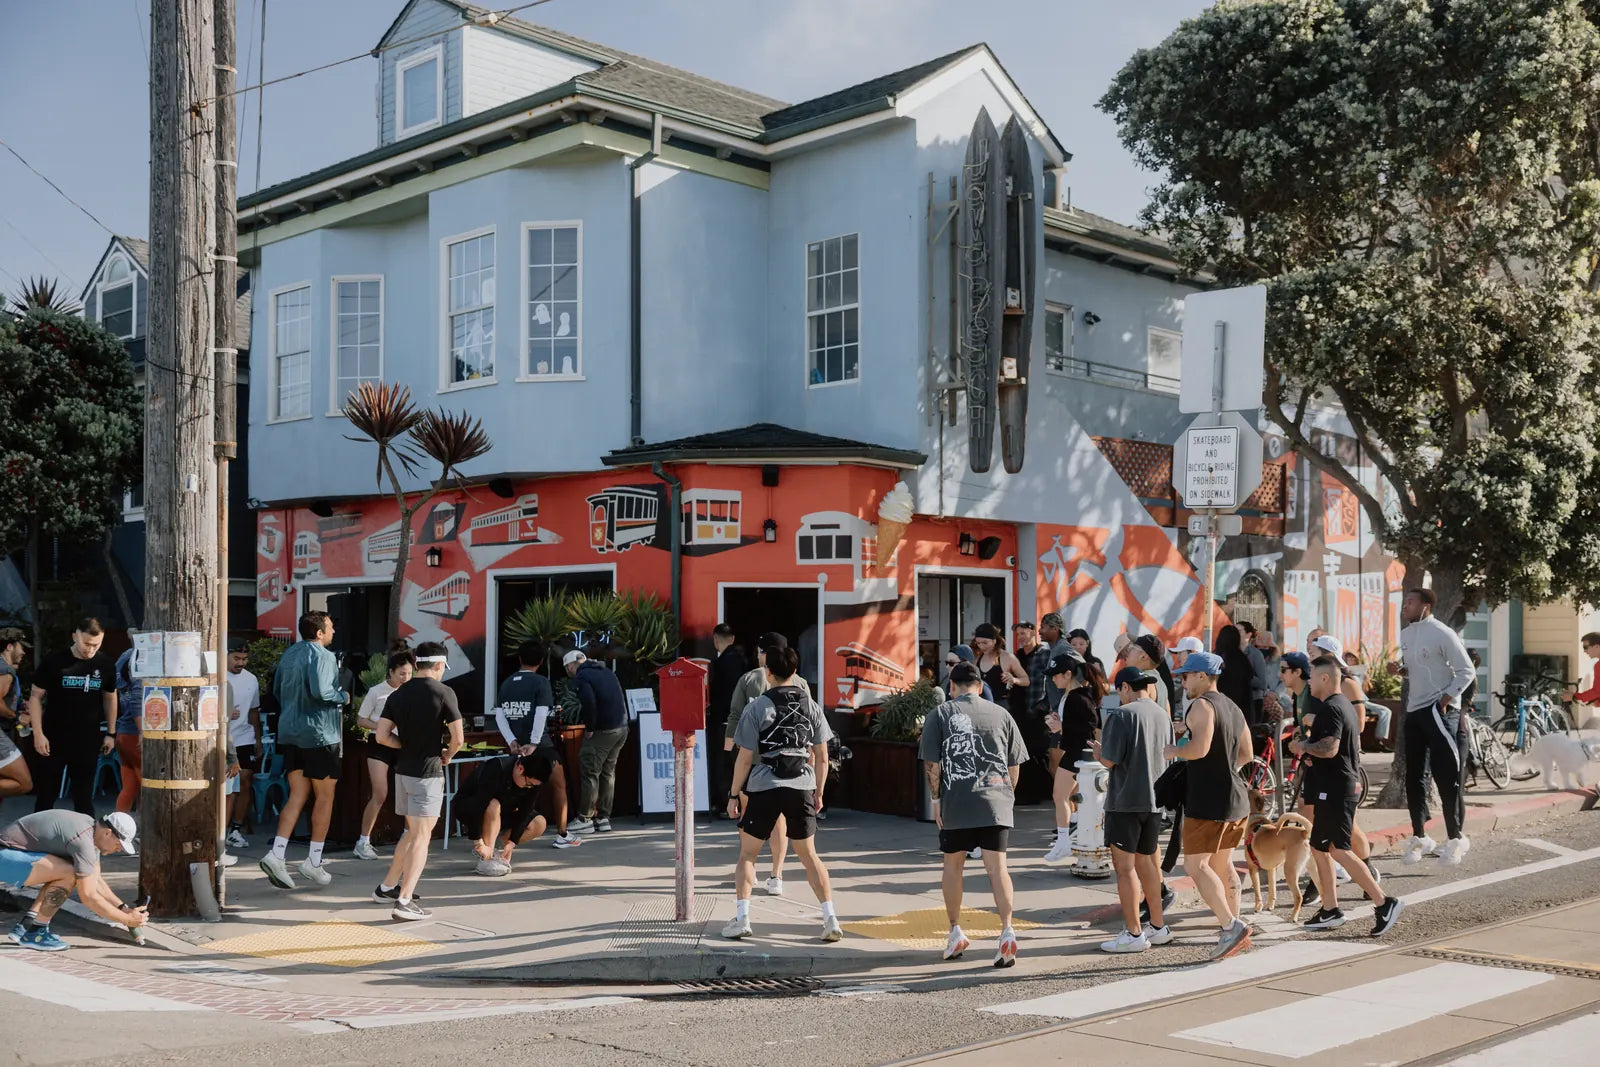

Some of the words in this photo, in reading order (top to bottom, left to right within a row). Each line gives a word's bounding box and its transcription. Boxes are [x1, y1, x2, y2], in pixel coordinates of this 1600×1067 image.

[1193, 435, 1231, 445] SKATEBOARD
[1205, 449, 1218, 458] AND
[1188, 463, 1211, 471] BICYCLE
[1214, 462, 1235, 471] RIDING
[1193, 476, 1228, 485] PROHIBITED
[1189, 490, 1198, 499] ON
[1201, 489, 1231, 498] SIDEWALK
[62, 679, 102, 688] CHAMPONS
[510, 701, 531, 709] FAKE
[646, 742, 701, 760] ORR
[951, 740, 972, 757] 22
